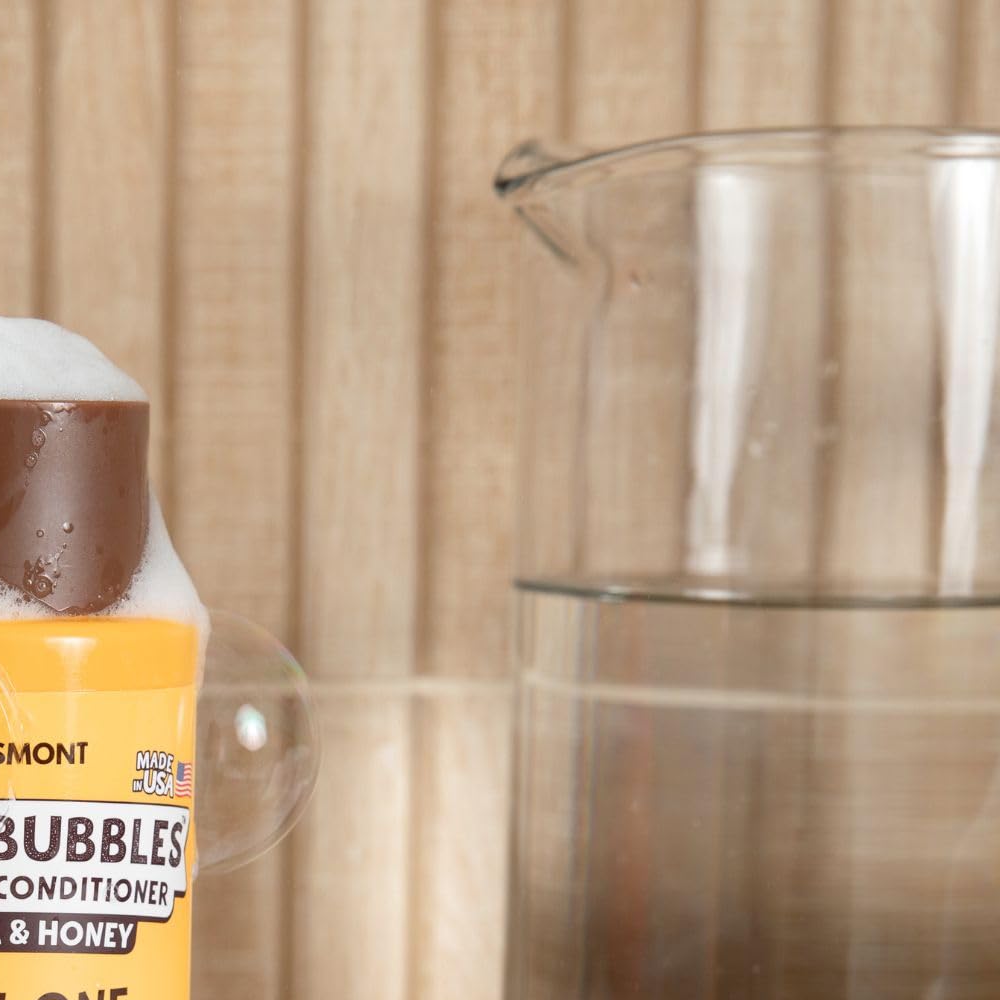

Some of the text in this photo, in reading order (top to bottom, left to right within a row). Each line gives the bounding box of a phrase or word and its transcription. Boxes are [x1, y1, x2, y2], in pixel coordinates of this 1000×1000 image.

[136, 751, 174, 773] MADE
[132, 769, 174, 798] IN USA
[10, 919, 30, 945] &
[38, 920, 134, 948] HONEY
